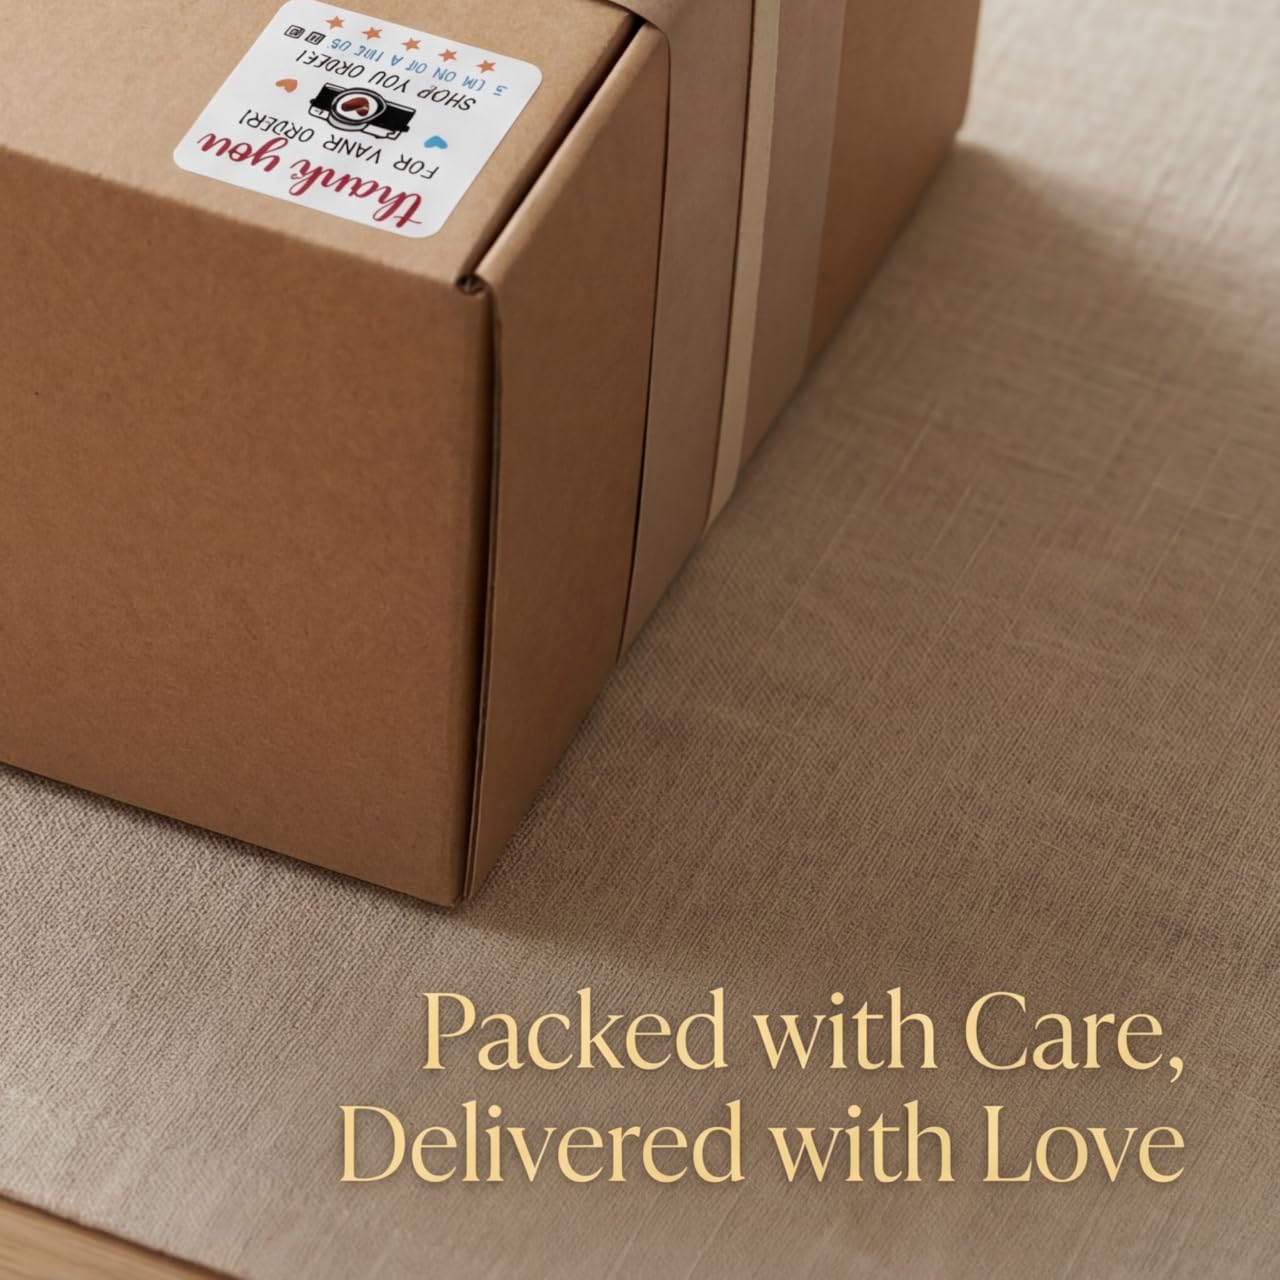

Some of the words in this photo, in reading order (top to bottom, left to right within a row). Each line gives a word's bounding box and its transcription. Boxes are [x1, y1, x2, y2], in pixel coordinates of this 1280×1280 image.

[368, 71, 411, 94] YOU
[238, 108, 316, 143] ORDER!
[196, 131, 289, 173] you
[392, 152, 440, 180] FOR
[288, 157, 424, 229] thank
